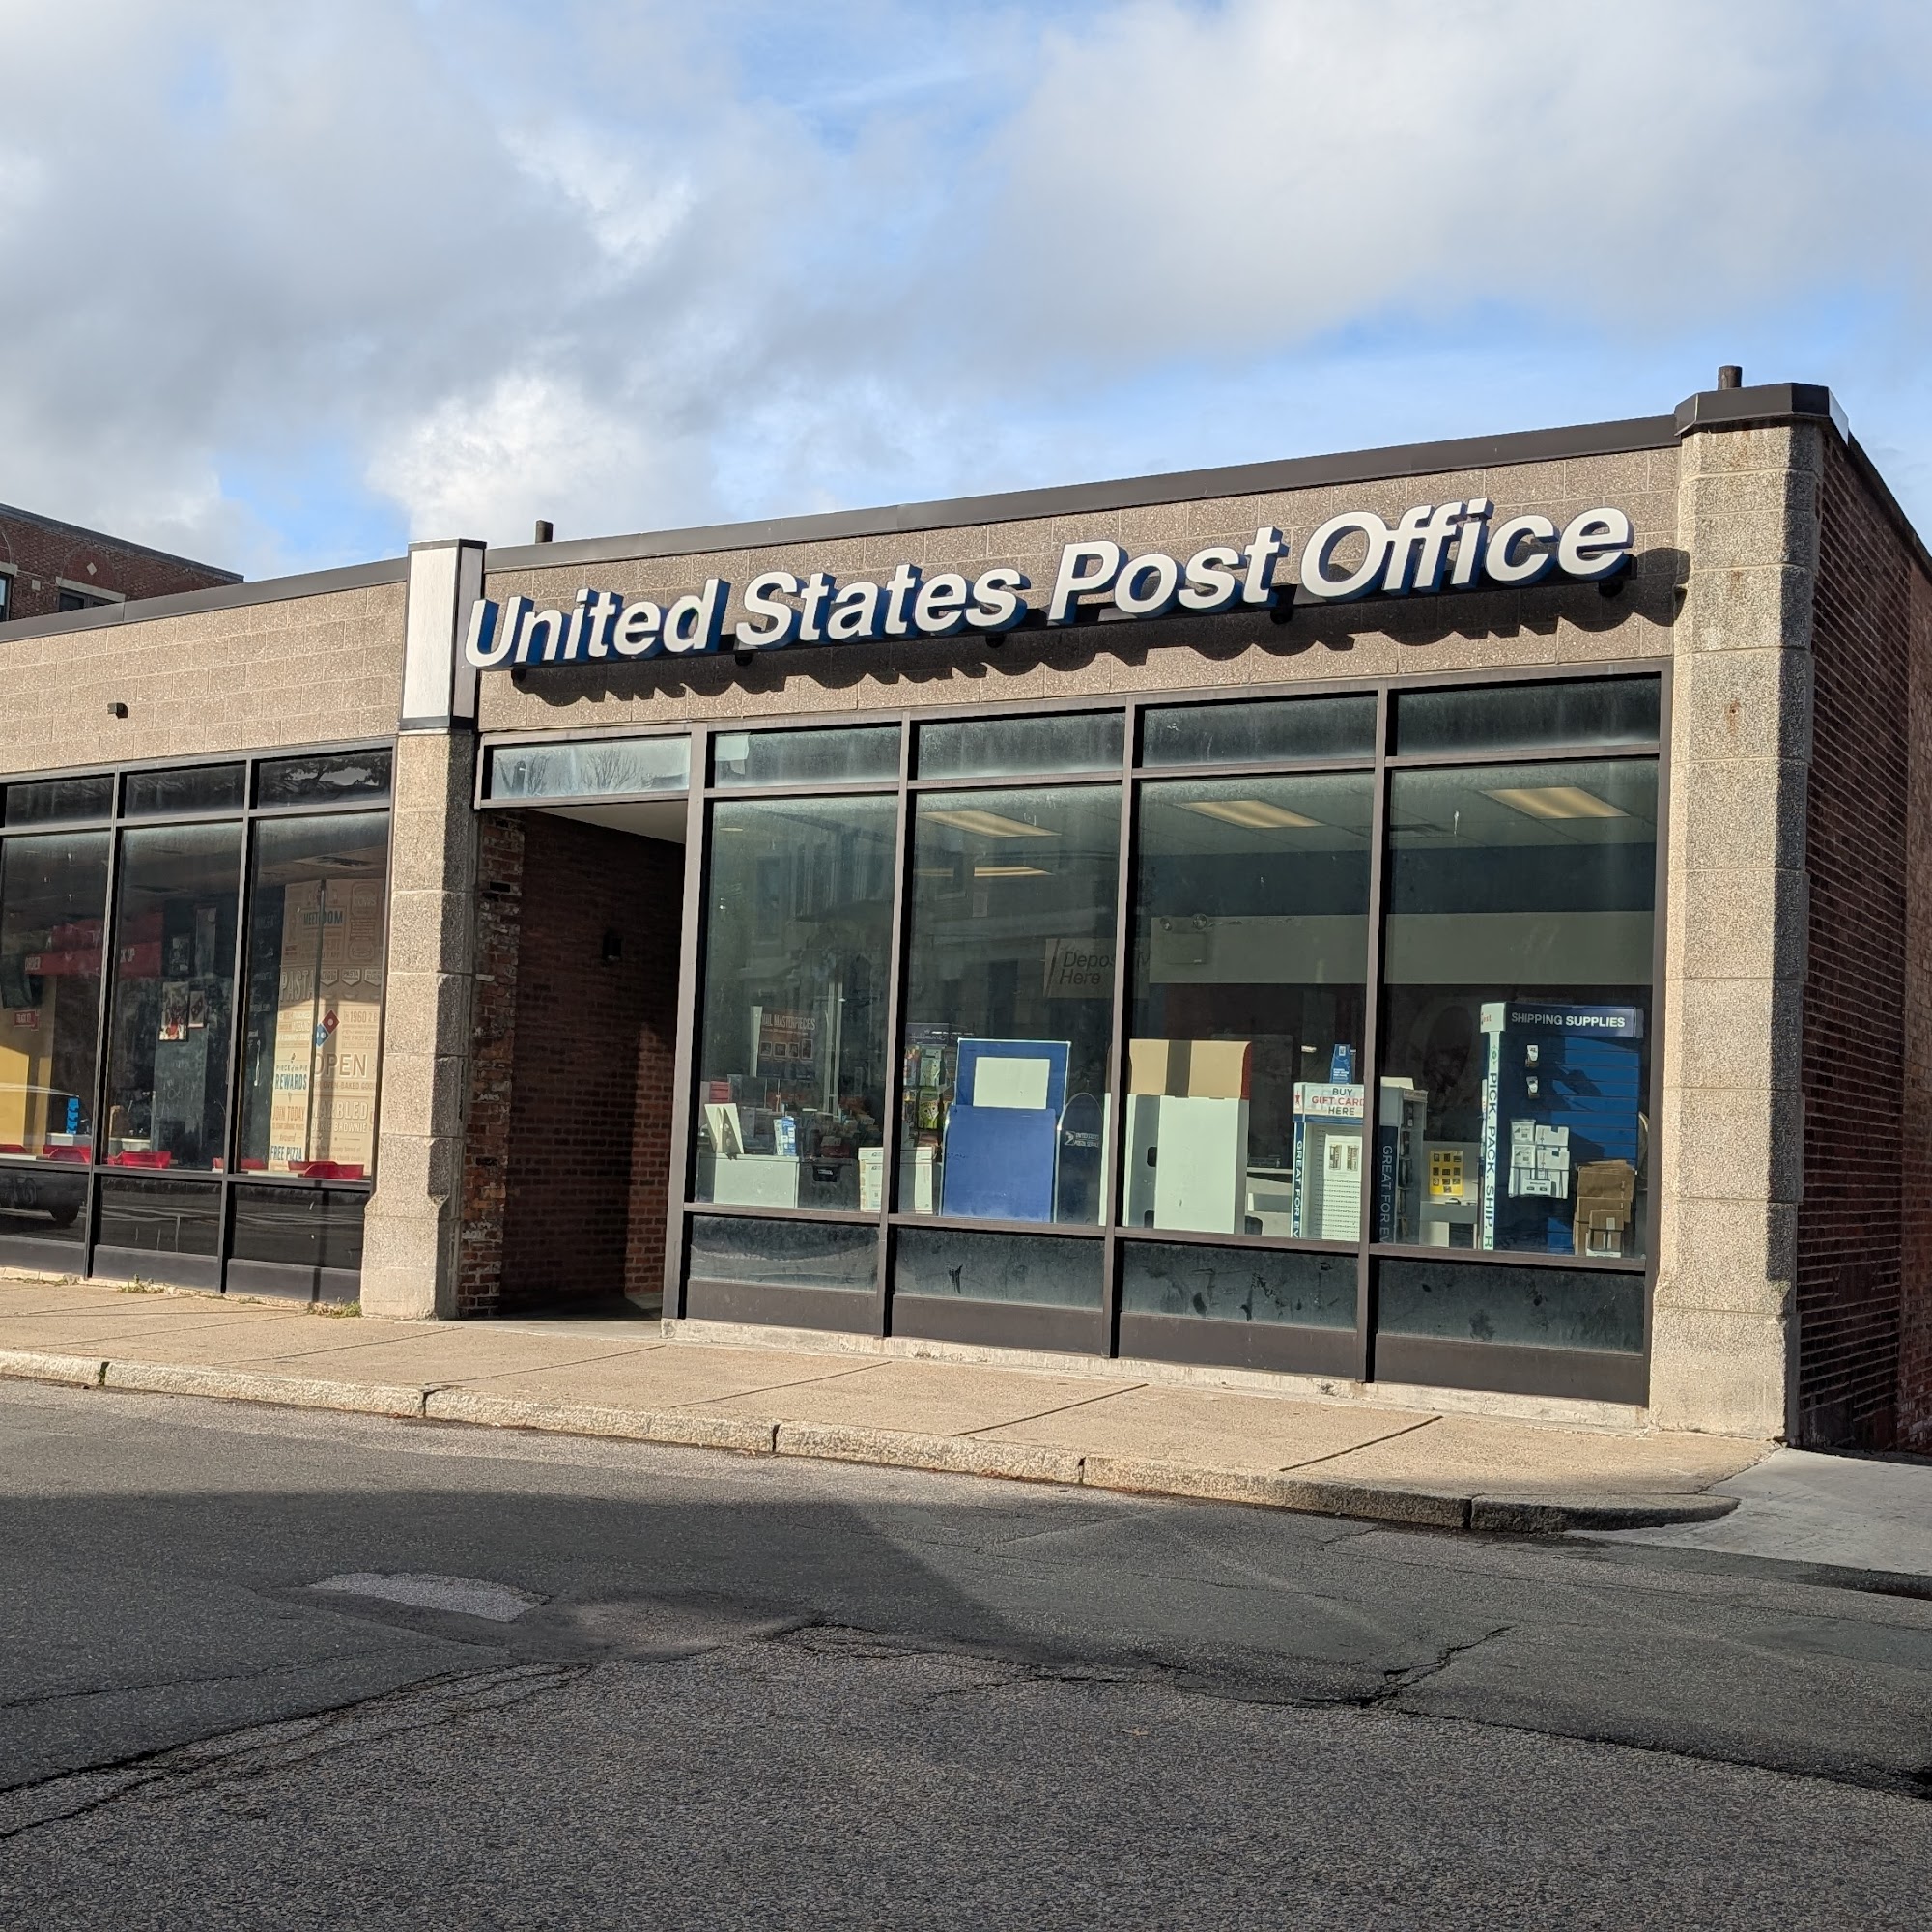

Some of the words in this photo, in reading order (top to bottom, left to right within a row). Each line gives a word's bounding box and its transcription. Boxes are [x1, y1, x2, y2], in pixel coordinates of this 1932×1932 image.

[464, 578, 726, 668] United
[735, 563, 1026, 647] States
[1047, 525, 1285, 621] Post
[1299, 497, 1633, 598] Office
[1064, 951, 1117, 971] Depos
[1060, 969, 1101, 984] Here
[280, 970, 315, 1002] PASTA
[350, 1010, 367, 1023] 1960
[1511, 1011, 1563, 1025] SHIPPING
[1566, 1015, 1626, 1028] SUPPLIES
[315, 1053, 366, 1076] OPEN
[274, 1073, 308, 1090] REWARDS
[1311, 1095, 1335, 1104] GIFT
[1338, 1097, 1364, 1106] CARD
[1332, 1088, 1353, 1096] BUY
[1488, 1072, 1497, 1120] PICK.
[287, 1105, 305, 1122] TODAY
[1328, 1106, 1355, 1116] HERE
[333, 1122, 367, 1133] BROWNIE
[270, 1145, 285, 1160] FREE
[286, 1146, 302, 1161] PIZZA
[1486, 1125, 1496, 1179] PACK.
[1381, 1145, 1393, 1191] GREAT
[1379, 1194, 1391, 1223] FOR
